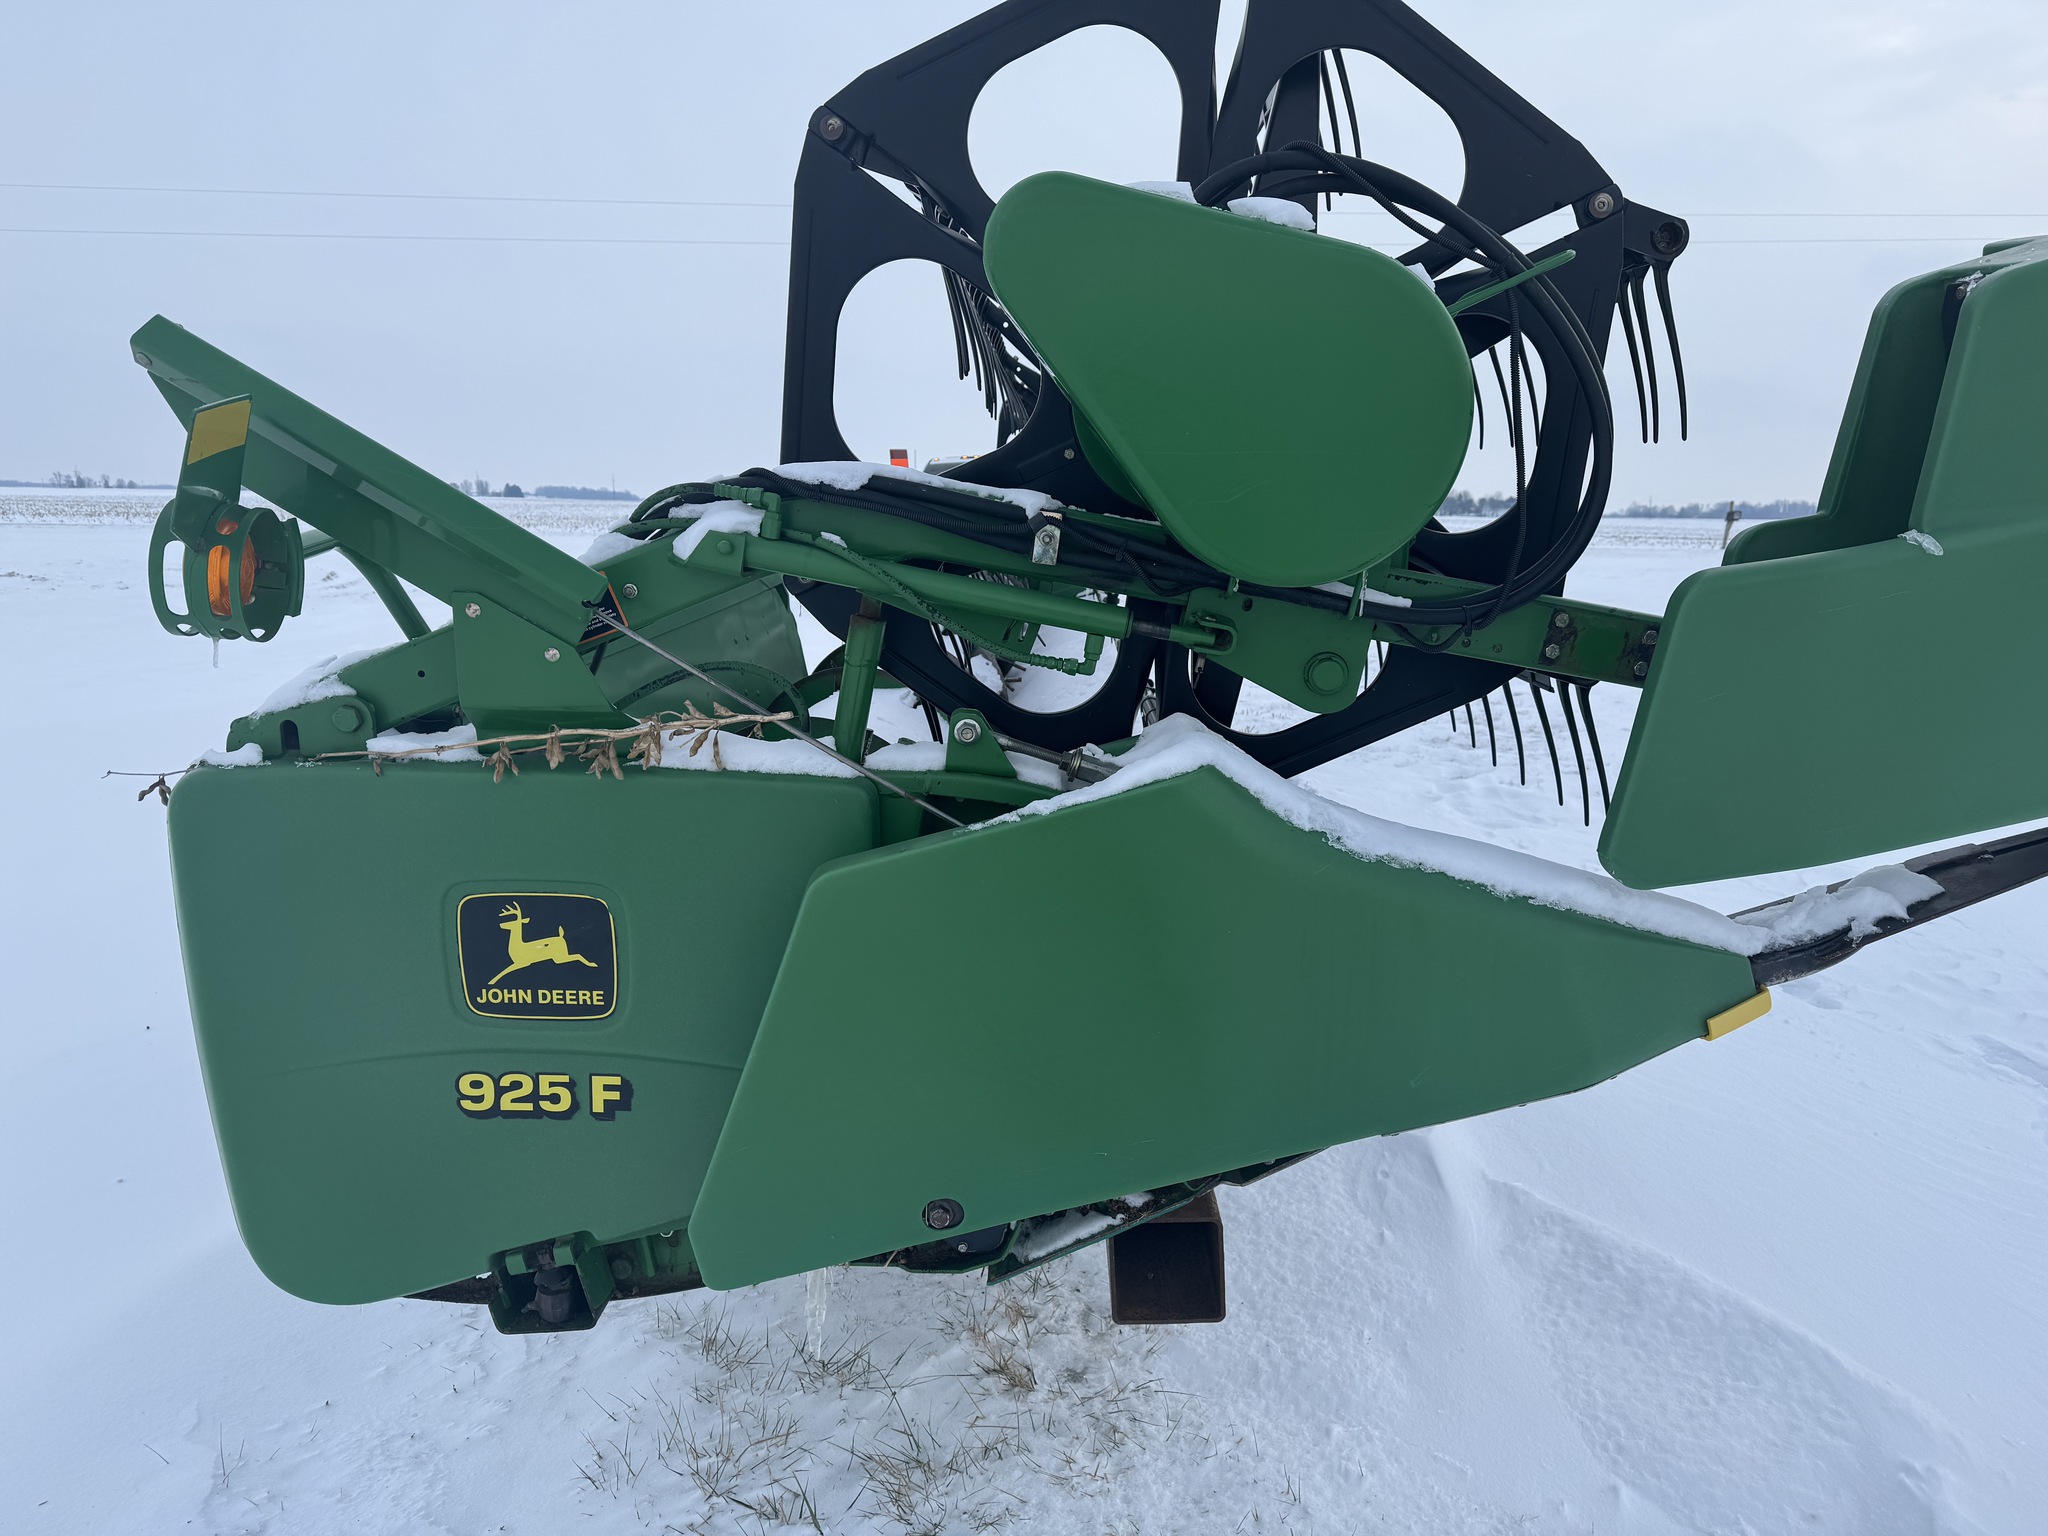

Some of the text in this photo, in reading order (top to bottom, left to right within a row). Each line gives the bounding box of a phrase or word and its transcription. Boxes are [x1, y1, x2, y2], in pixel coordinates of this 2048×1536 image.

[476, 988, 605, 1005] JOHN DEERE
[457, 1073, 623, 1114] 925 F
